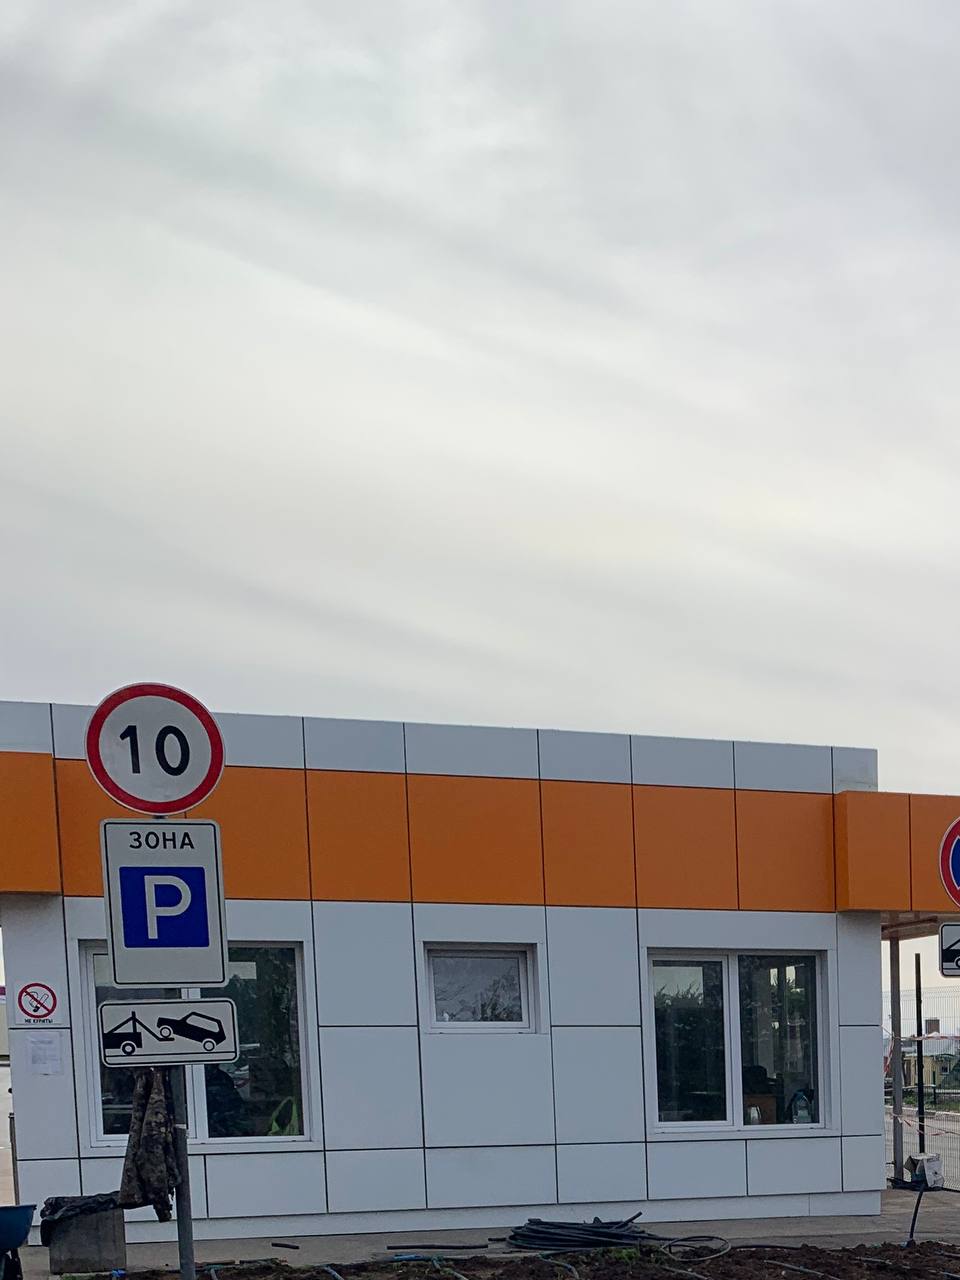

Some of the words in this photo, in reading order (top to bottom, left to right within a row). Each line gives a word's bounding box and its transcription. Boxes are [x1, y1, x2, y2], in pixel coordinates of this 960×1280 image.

[119, 725, 190, 776] 10
[129, 831, 195, 850] ЗОНА
[143, 875, 192, 939] P
